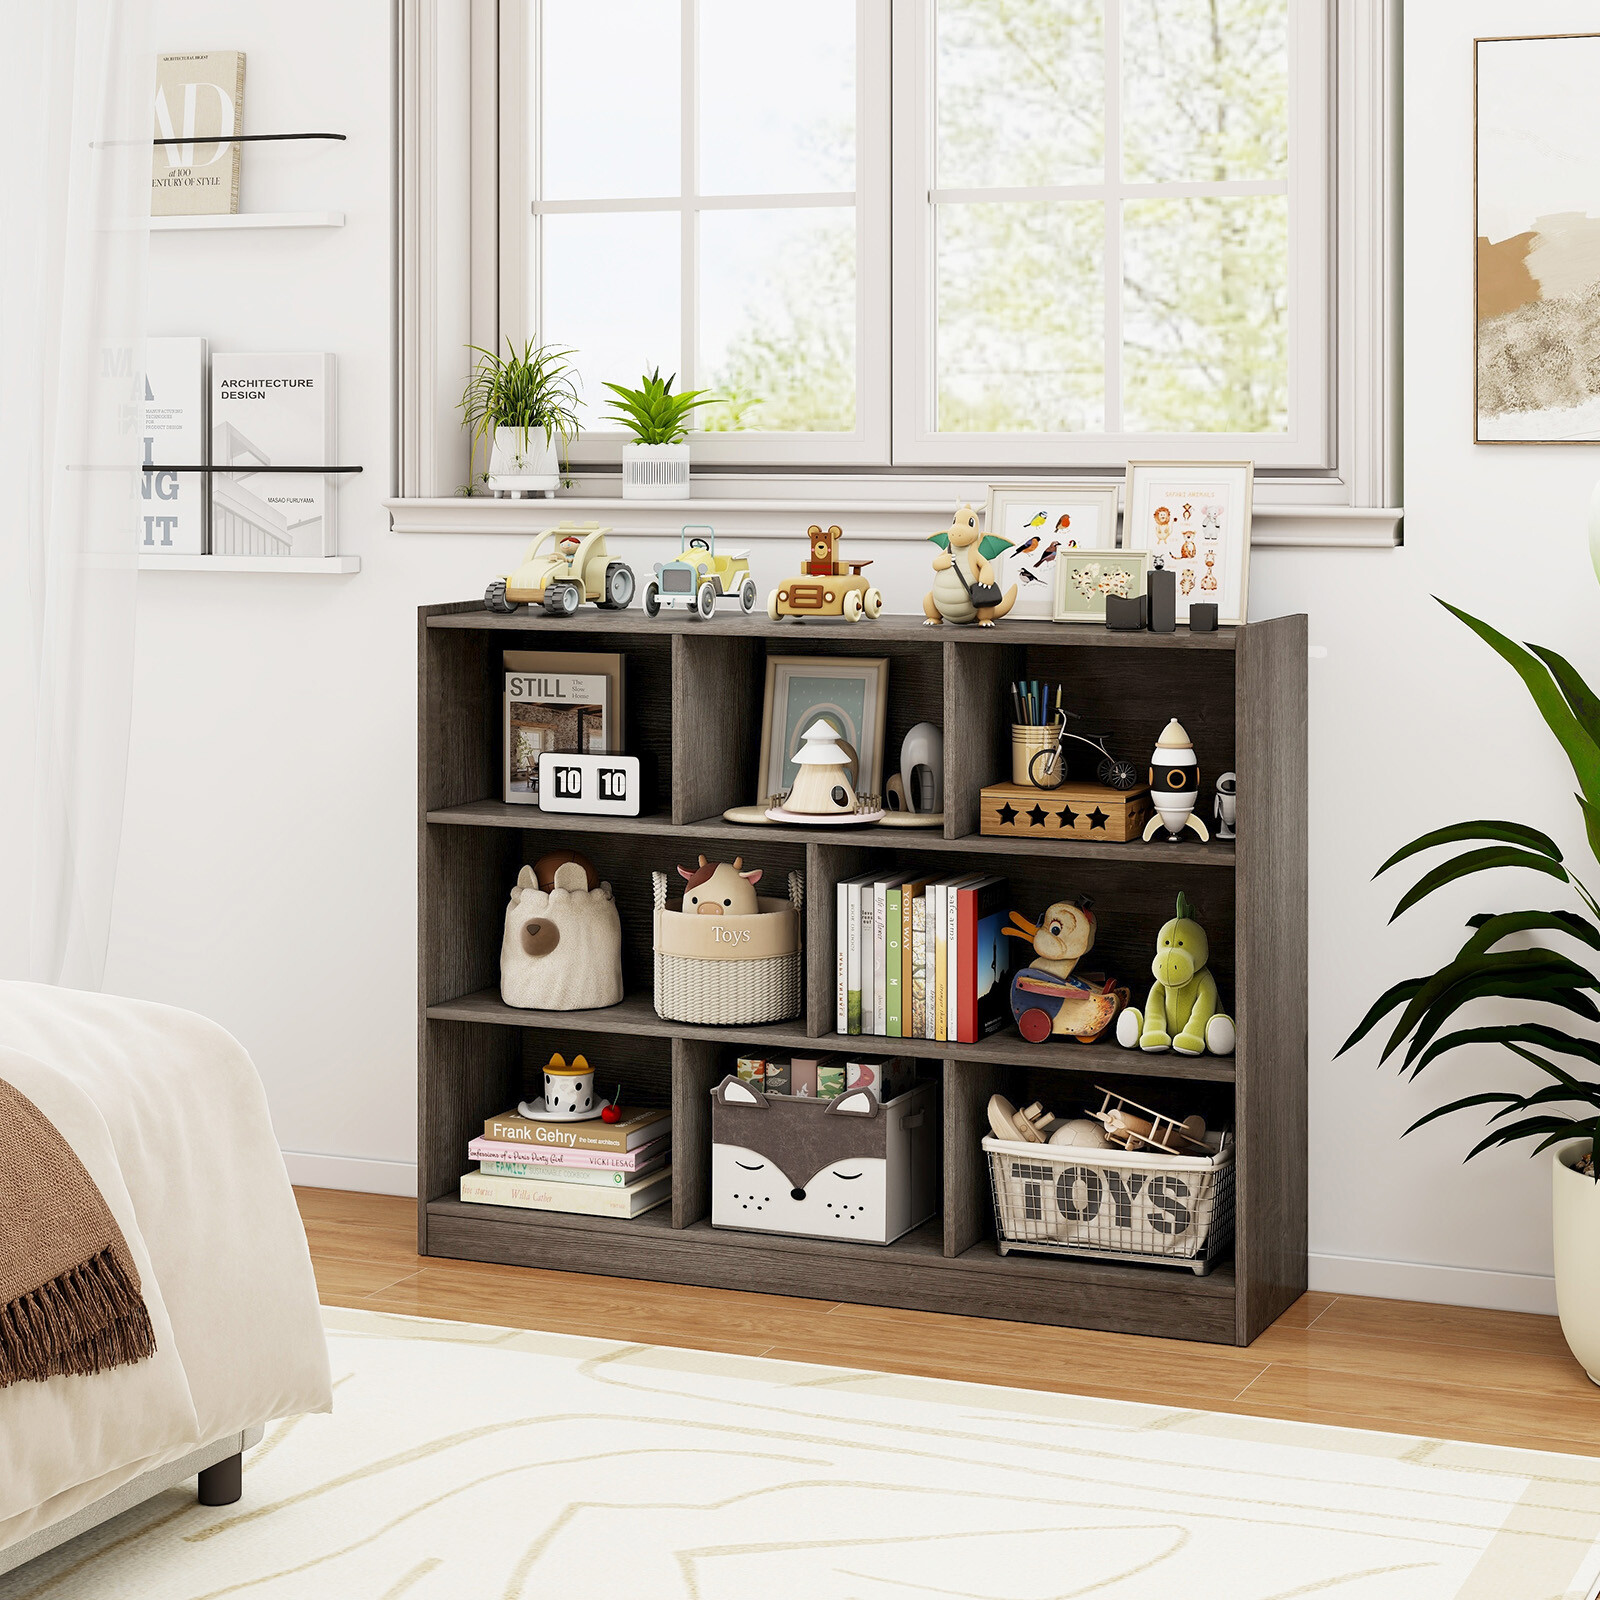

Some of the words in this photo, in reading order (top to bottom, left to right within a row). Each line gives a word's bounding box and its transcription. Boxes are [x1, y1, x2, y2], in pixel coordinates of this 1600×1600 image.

[151, 179, 183, 188] ENTURY
[184, 178, 195, 186] OF
[196, 177, 221, 186] STYLE
[177, 169, 191, 177] 100
[220, 379, 314, 388] ARCHITECTURE
[221, 391, 266, 400] DESIGN
[510, 677, 567, 698] STILL
[557, 769, 581, 794] 10
[602, 772, 626, 797] 10
[949, 895, 958, 914] safe
[711, 926, 751, 947] Toys
[889, 903, 898, 1022] HOME
[493, 1123, 532, 1140] Frank
[535, 1127, 577, 1147] Gehry
[500, 1150, 507, 1161] of
[513, 1151, 530, 1160] Paris
[531, 1152, 549, 1165] Party
[549, 1154, 564, 1164] Girl
[589, 1158, 609, 1166] VICKI
[495, 1161, 528, 1176] FAMILY
[511, 1188, 531, 1201] Willa
[532, 1191, 553, 1203] Cather
[1011, 1162, 1192, 1235] TOYS
